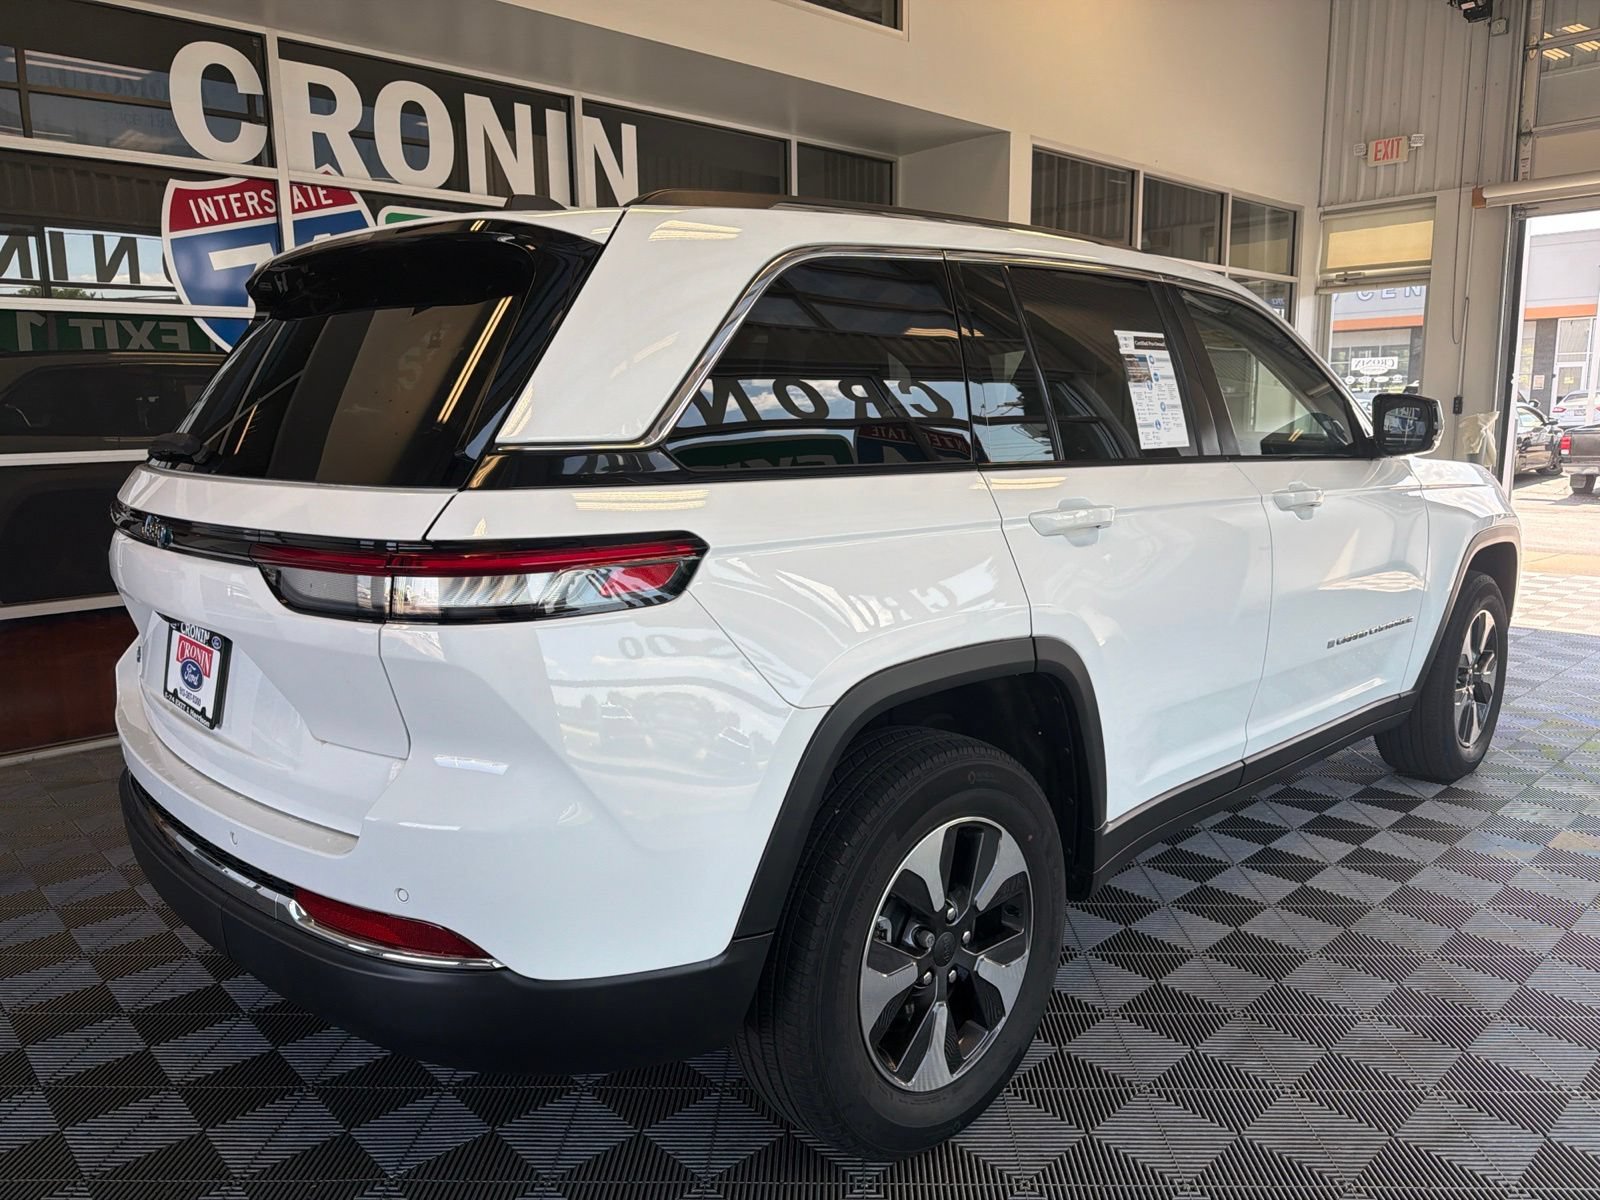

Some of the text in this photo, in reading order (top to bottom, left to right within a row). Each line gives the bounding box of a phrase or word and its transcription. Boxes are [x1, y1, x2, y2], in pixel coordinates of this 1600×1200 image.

[169, 41, 638, 205] CRONIN
[1374, 138, 1402, 161] EXIT
[188, 185, 333, 224] INTERSATE
[180, 621, 210, 643] CRONIN
[179, 640, 212, 677] CRONIN
[184, 663, 200, 686] Ford
